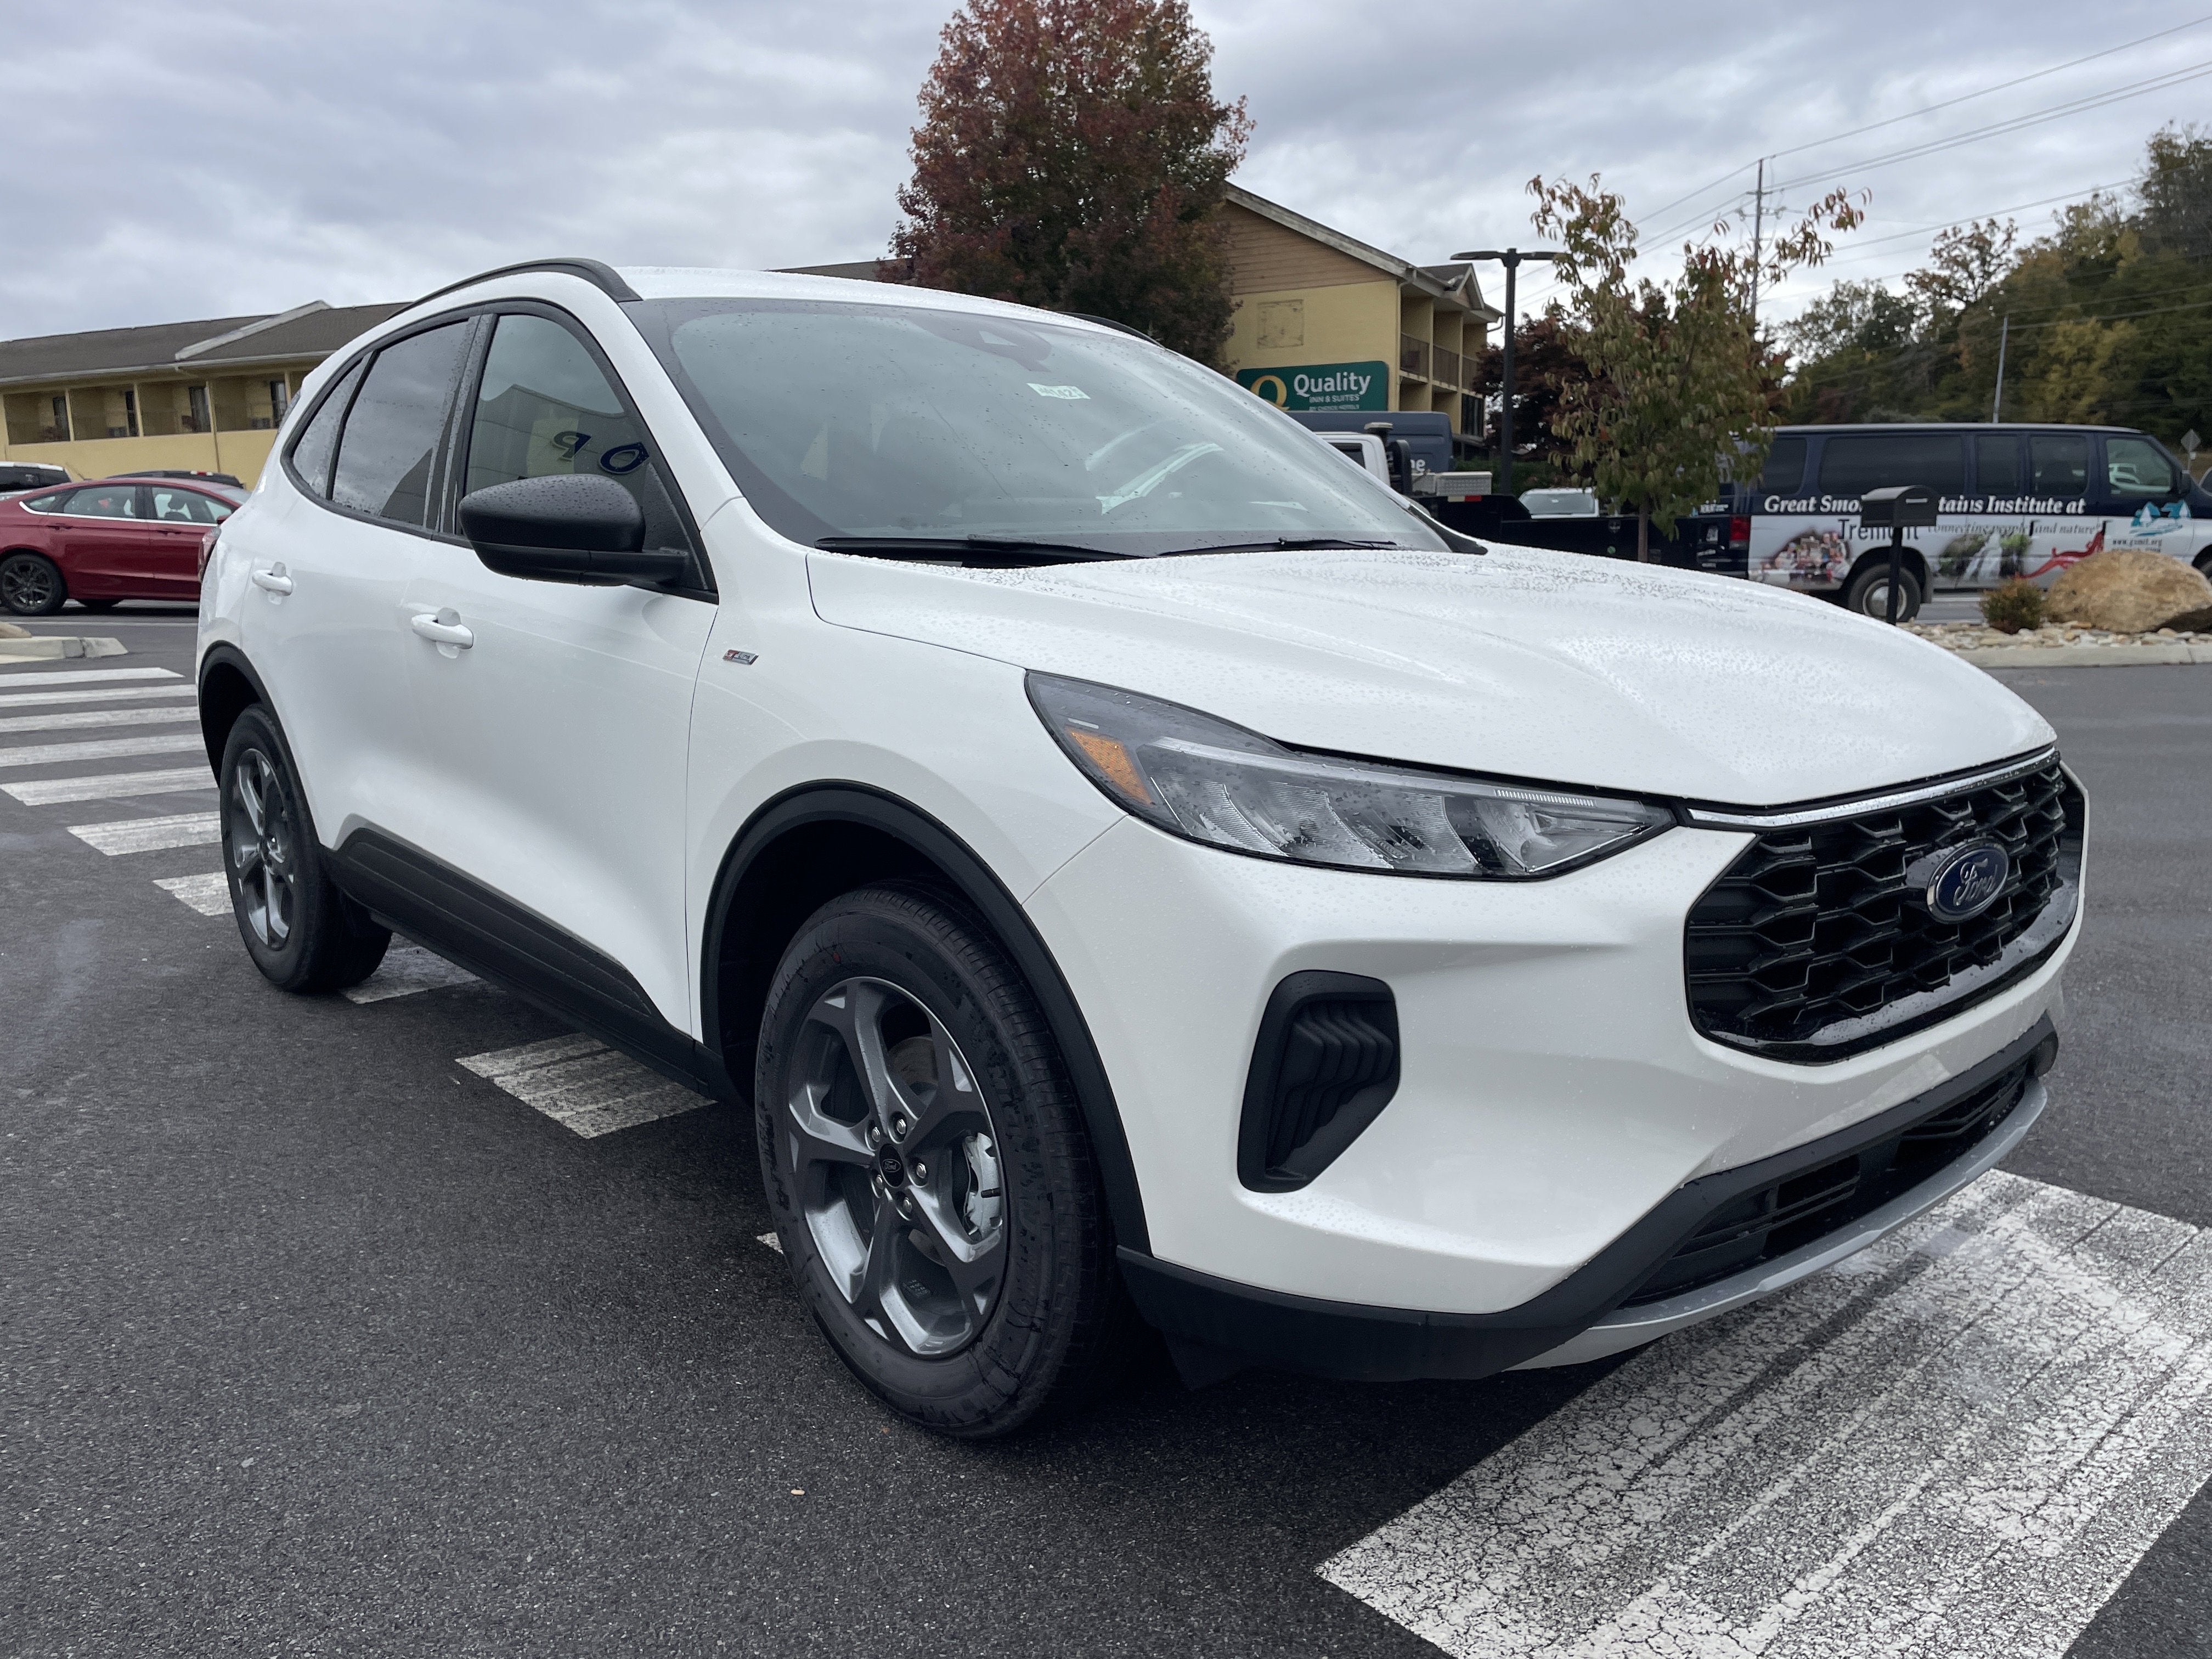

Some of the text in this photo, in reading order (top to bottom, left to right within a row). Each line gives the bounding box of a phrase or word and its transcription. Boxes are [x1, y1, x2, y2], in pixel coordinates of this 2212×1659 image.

[1294, 371, 1371, 397] Quality
[1332, 394, 1360, 402] SUITES
[1764, 495, 2086, 514] Great Smo tains Institute at
[1953, 857, 1999, 907] Ford
